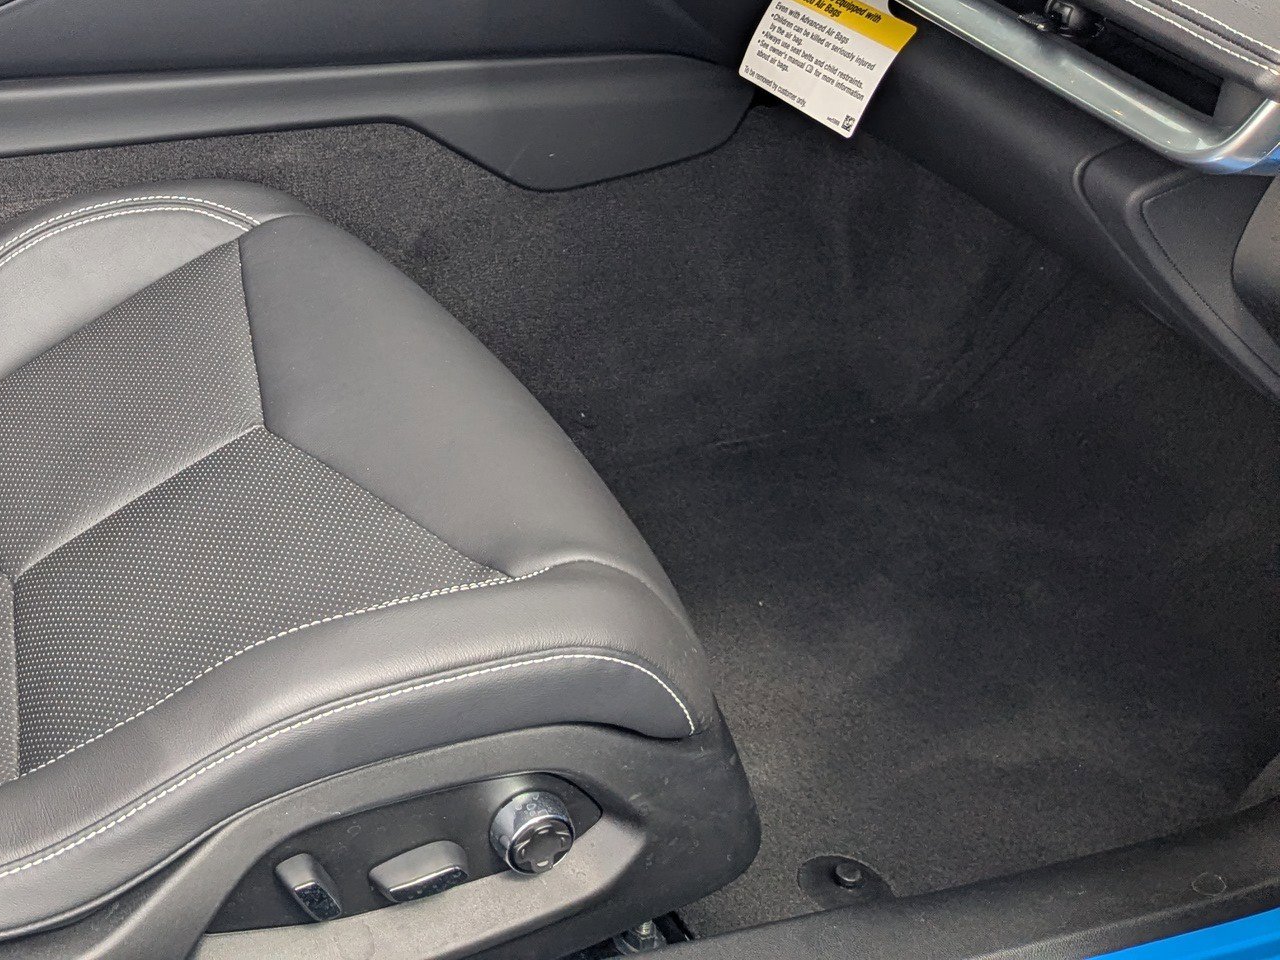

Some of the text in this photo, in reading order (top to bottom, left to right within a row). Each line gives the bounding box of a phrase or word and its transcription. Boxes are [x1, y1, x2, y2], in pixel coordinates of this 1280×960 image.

[775, 1, 849, 44] Even with Advanced Air Bags
[824, 3, 842, 17] Bags
[865, 11, 881, 23] with
[769, 22, 777, 32] by
[776, 26, 785, 35] the
[792, 35, 803, 46] bag.
[793, 25, 803, 34] can
[803, 28, 810, 37] be
[810, 32, 826, 45] killed
[831, 44, 856, 61] seriously
[855, 55, 876, 71] injured
[757, 50, 770, 62] about
[769, 56, 777, 65] air
[769, 46, 787, 60] owner's
[787, 56, 806, 69] manual
[814, 69, 822, 77] for
[821, 74, 835, 85] more
[835, 80, 864, 101] information
[781, 41, 791, 49] use
[790, 46, 802, 55] seat
[801, 50, 814, 62] belts
[814, 58, 825, 68] and
[824, 63, 838, 75] child
[837, 71, 863, 89] restraints.
[744, 65, 750, 74] To
[749, 68, 755, 77] be
[755, 73, 773, 87] removed
[772, 81, 778, 91] by
[777, 86, 797, 101] customer
